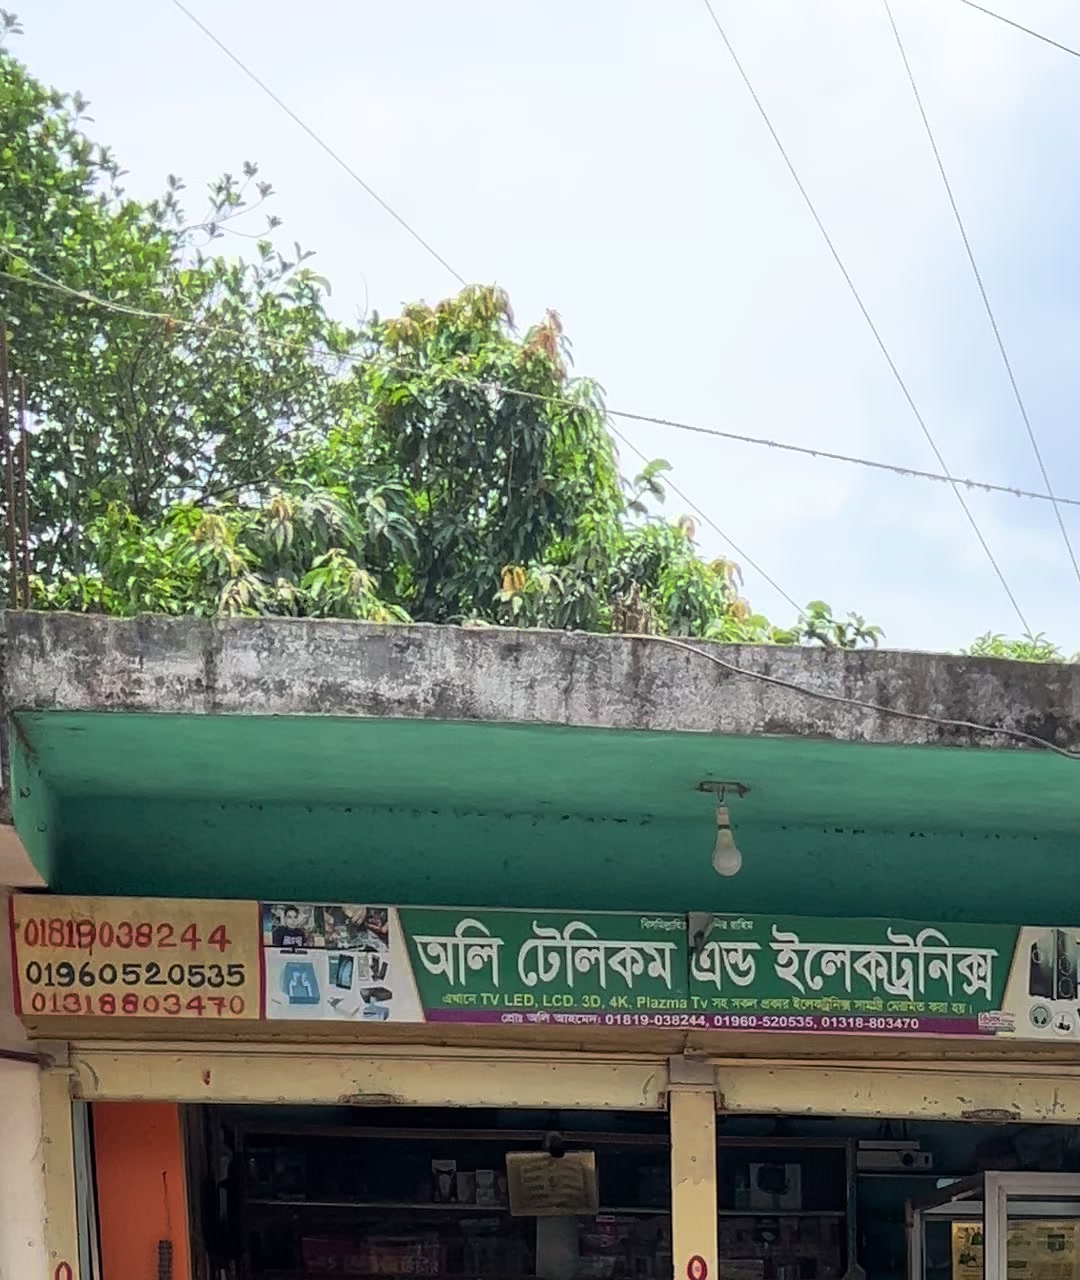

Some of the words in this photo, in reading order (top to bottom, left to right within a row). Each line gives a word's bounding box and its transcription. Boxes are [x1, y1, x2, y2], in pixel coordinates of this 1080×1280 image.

[24, 918, 232, 952] 01819038244
[412, 918, 504, 988] অলি
[518, 920, 678, 990] টেলিকম
[691, 940, 762, 992] এন্ড
[26, 961, 245, 988] 01960520535
[31, 992, 245, 1015] 01318803470
[480, 993, 499, 1006] TV
[503, 994, 539, 1008] LED,
[581, 995, 606, 1010] 3D,
[636, 996, 688, 1010] Plazma
[691, 996, 709, 1010] Tv
[527, 1011, 550, 1023] অলি
[604, 1013, 710, 1027] 01819-038244,
[714, 1015, 818, 1028] 01960-520535,
[821, 1016, 919, 1029] 01318-803470
